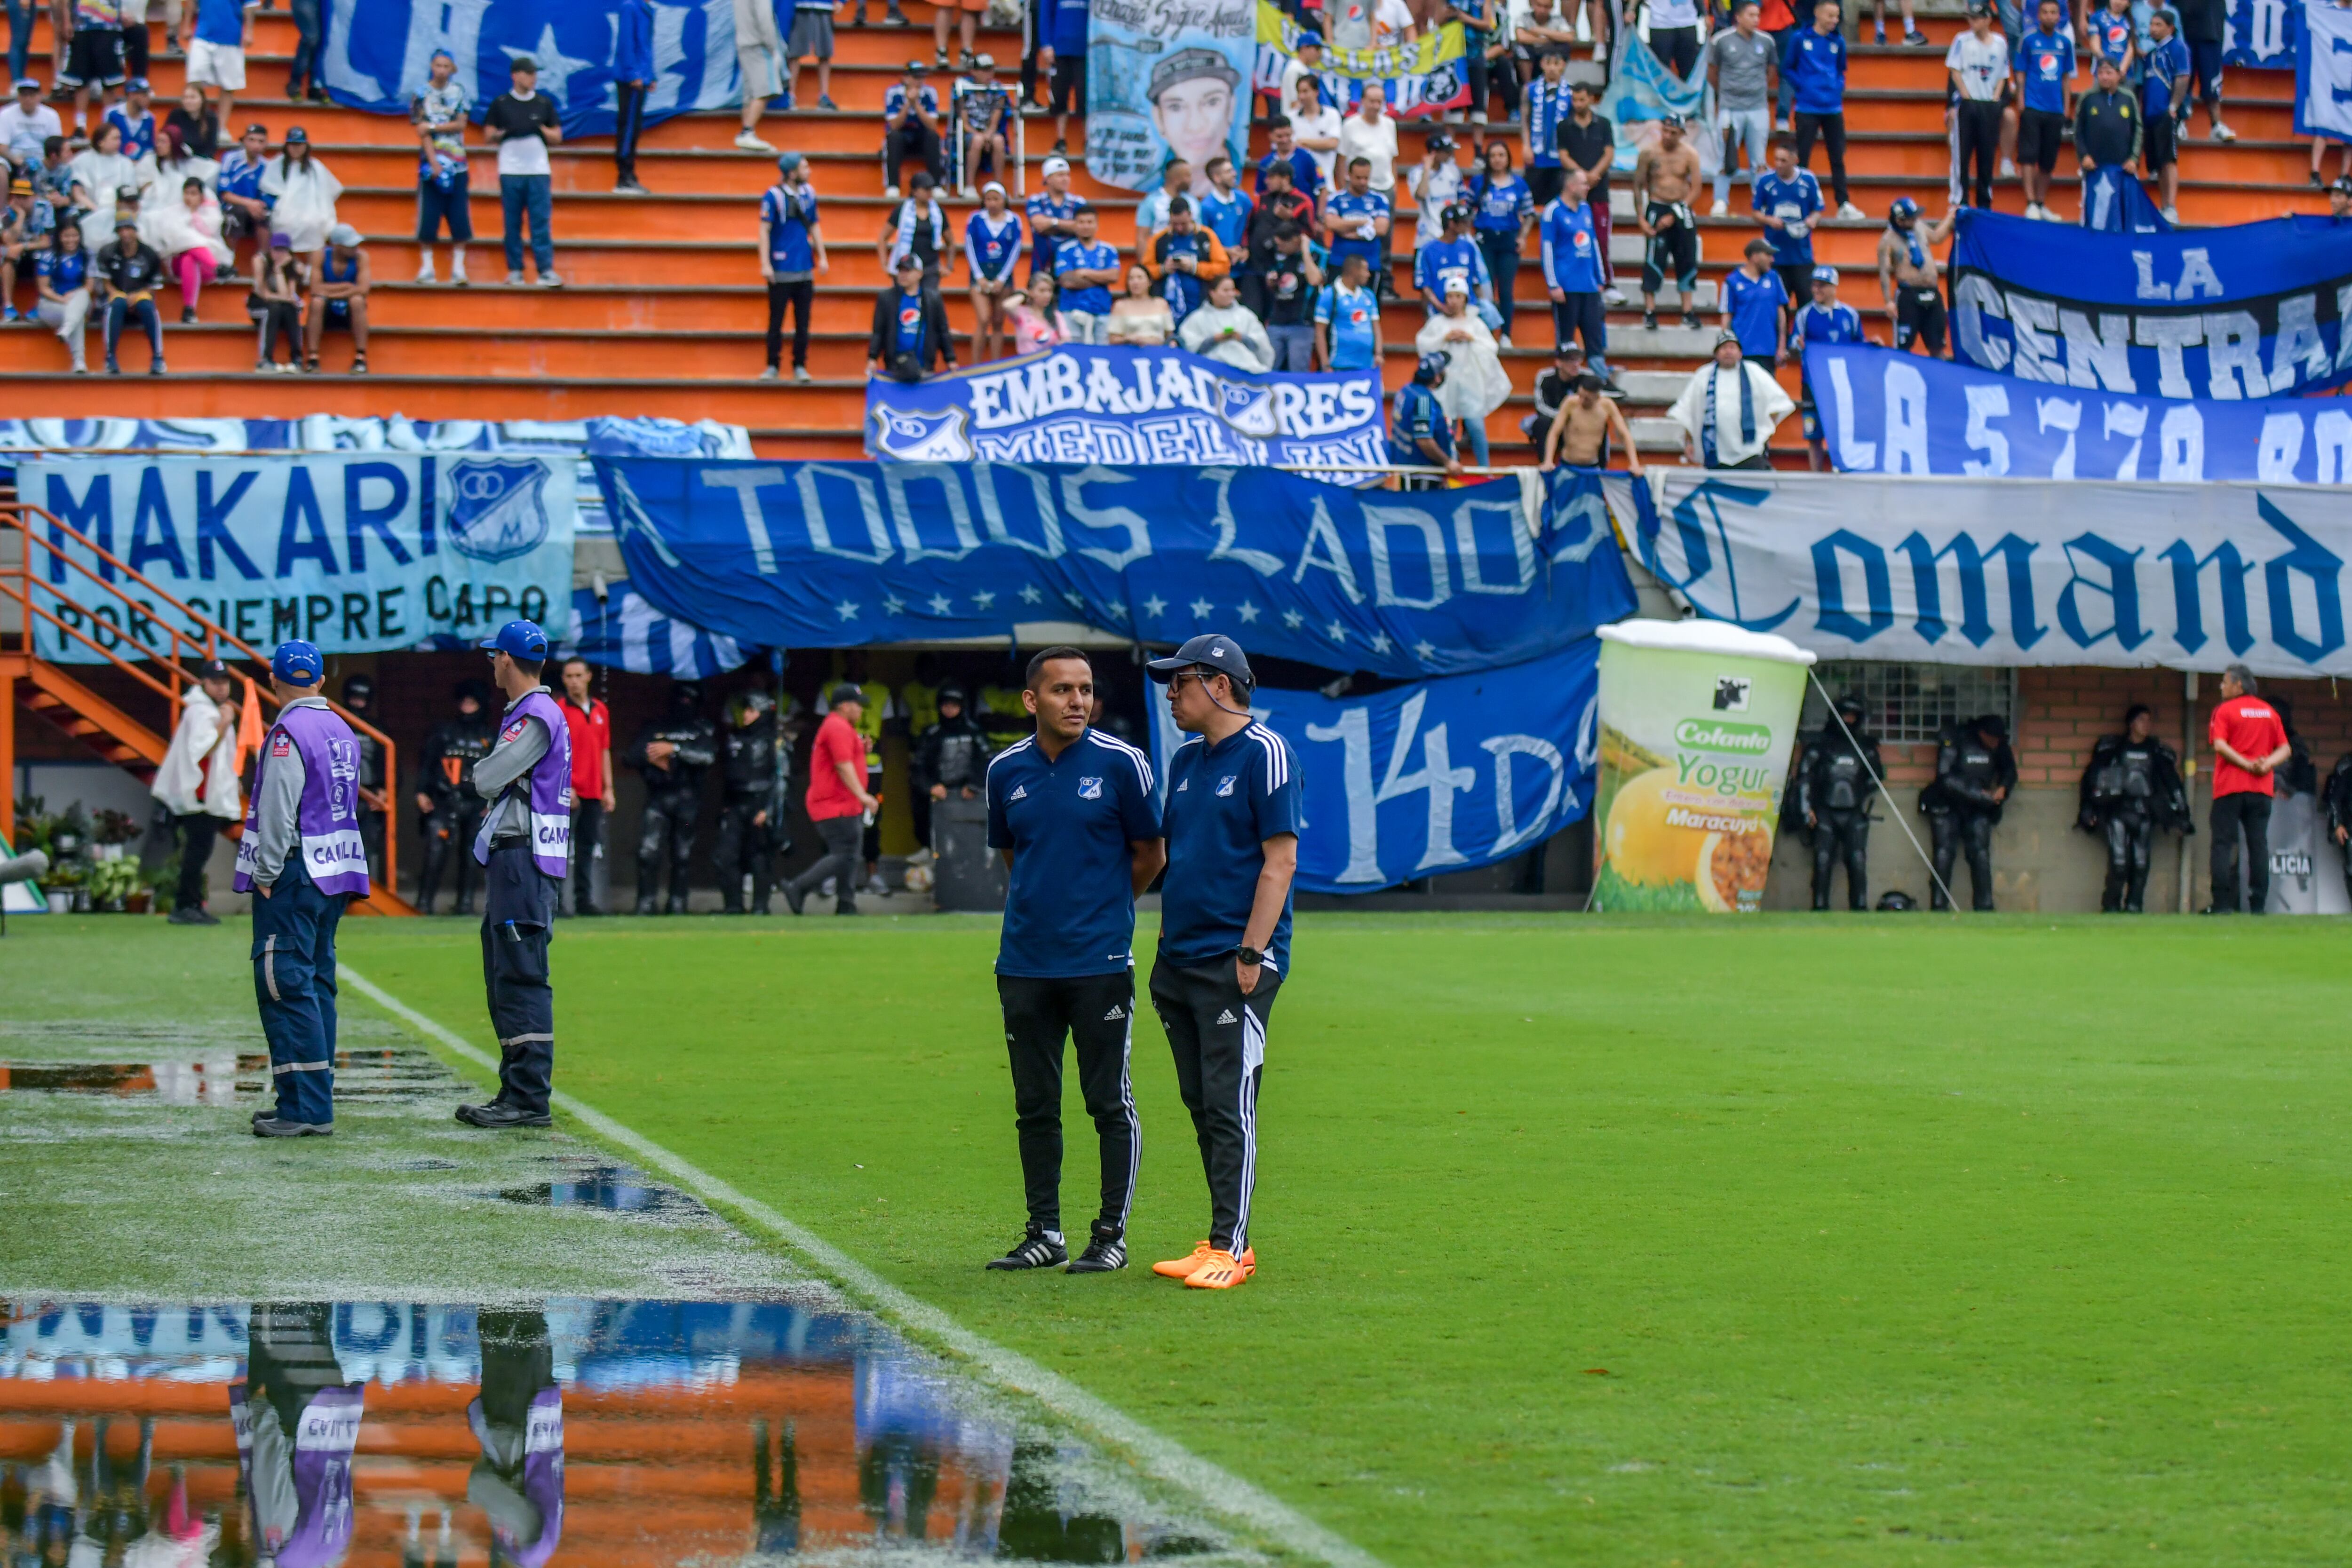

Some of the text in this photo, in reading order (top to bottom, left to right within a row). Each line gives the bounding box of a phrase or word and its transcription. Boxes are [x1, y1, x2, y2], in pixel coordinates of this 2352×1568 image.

[2132, 247, 2224, 301] LA
[967, 352, 1377, 439] EMBAJADRES
[1827, 358, 1930, 473] LA
[46, 455, 438, 585] MAKARI
[700, 462, 1152, 575] TODOS
[1197, 463, 1613, 610] LADOS
[425, 574, 548, 626] CAPO
[1636, 478, 2346, 664] Comand
[55, 597, 158, 652] POR
[183, 586, 408, 646] SIEMPRE
[1676, 721, 1771, 750] Colanta
[1305, 689, 1476, 884] 14
[2269, 856, 2311, 875] LICIA
